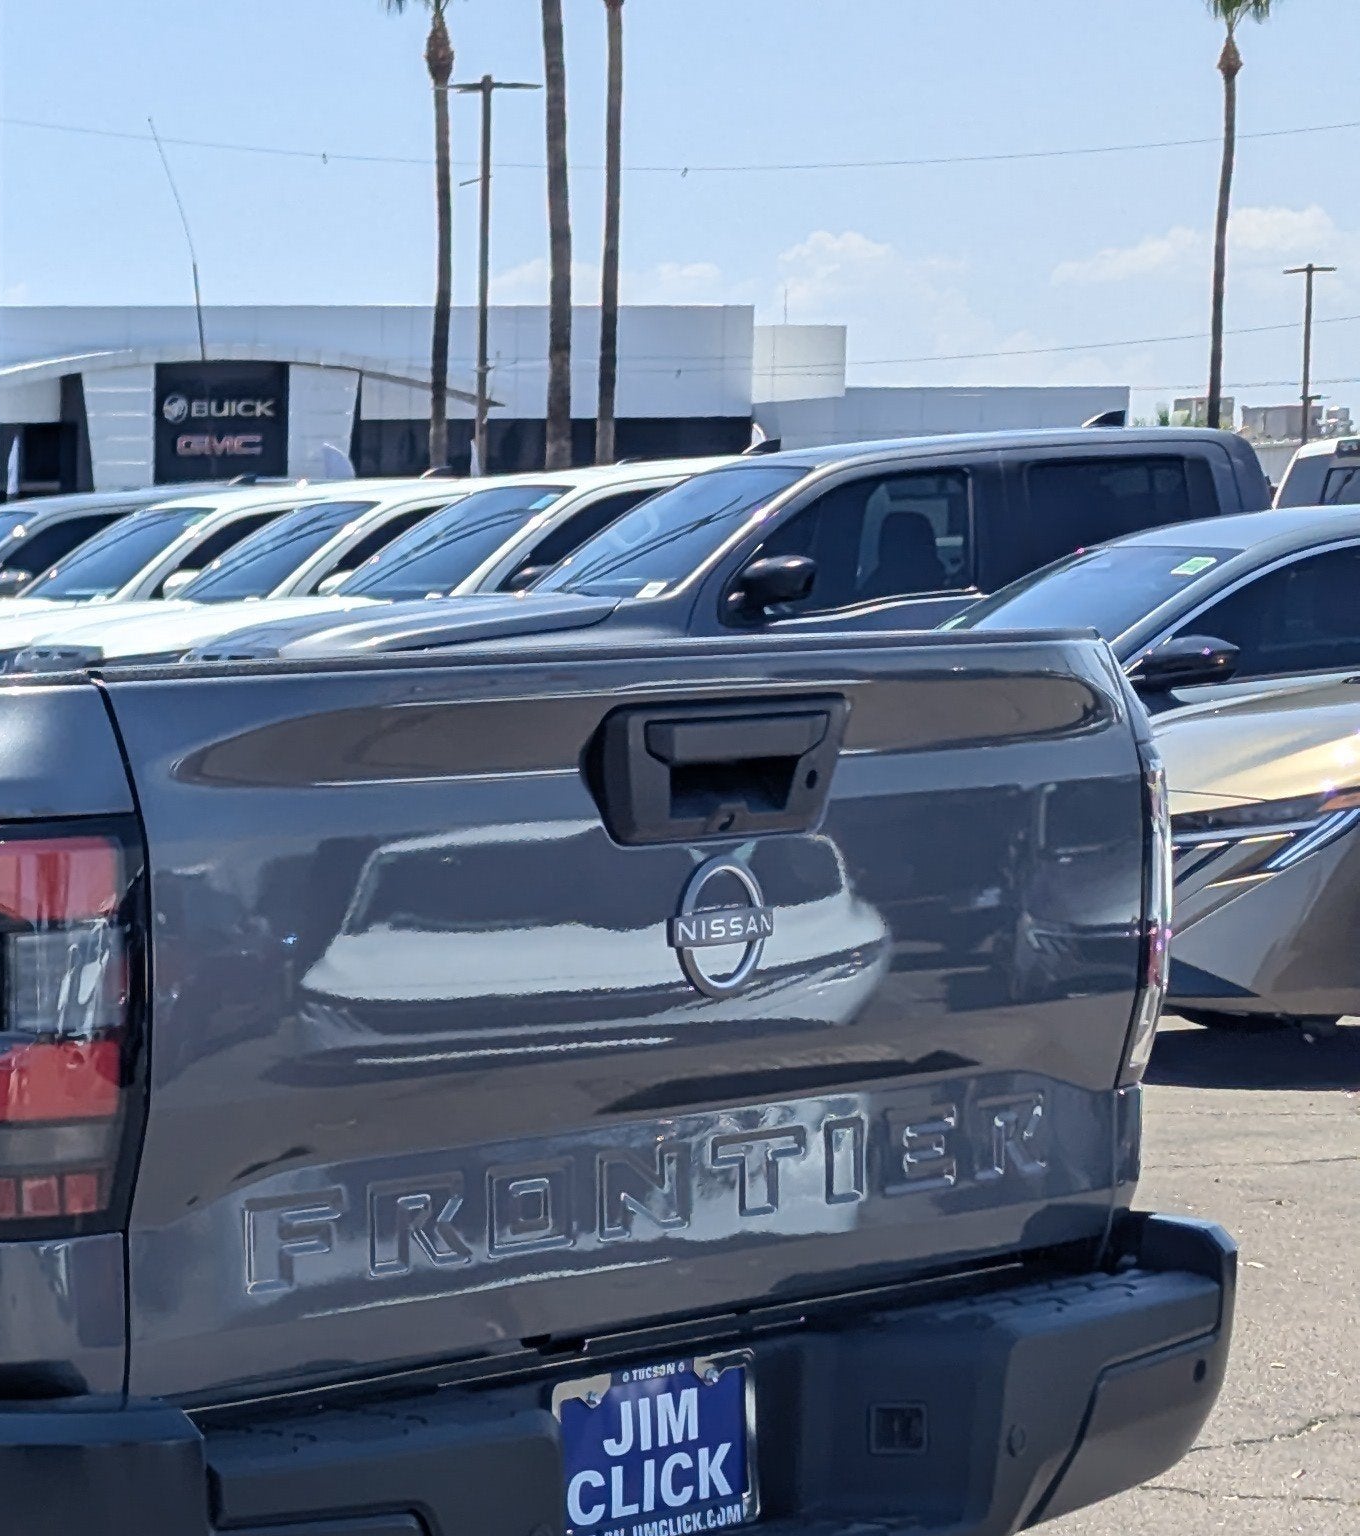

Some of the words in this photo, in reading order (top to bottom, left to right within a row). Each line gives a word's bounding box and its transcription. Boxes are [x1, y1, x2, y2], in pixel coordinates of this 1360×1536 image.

[190, 400, 276, 417] BUICK
[176, 435, 263, 455] GMC
[678, 914, 772, 941] NISSAN
[244, 1091, 1047, 1296] FRONTIER
[632, 1362, 676, 1381] TUCSON
[603, 1387, 699, 1457] JIM
[567, 1442, 733, 1526] CLICK
